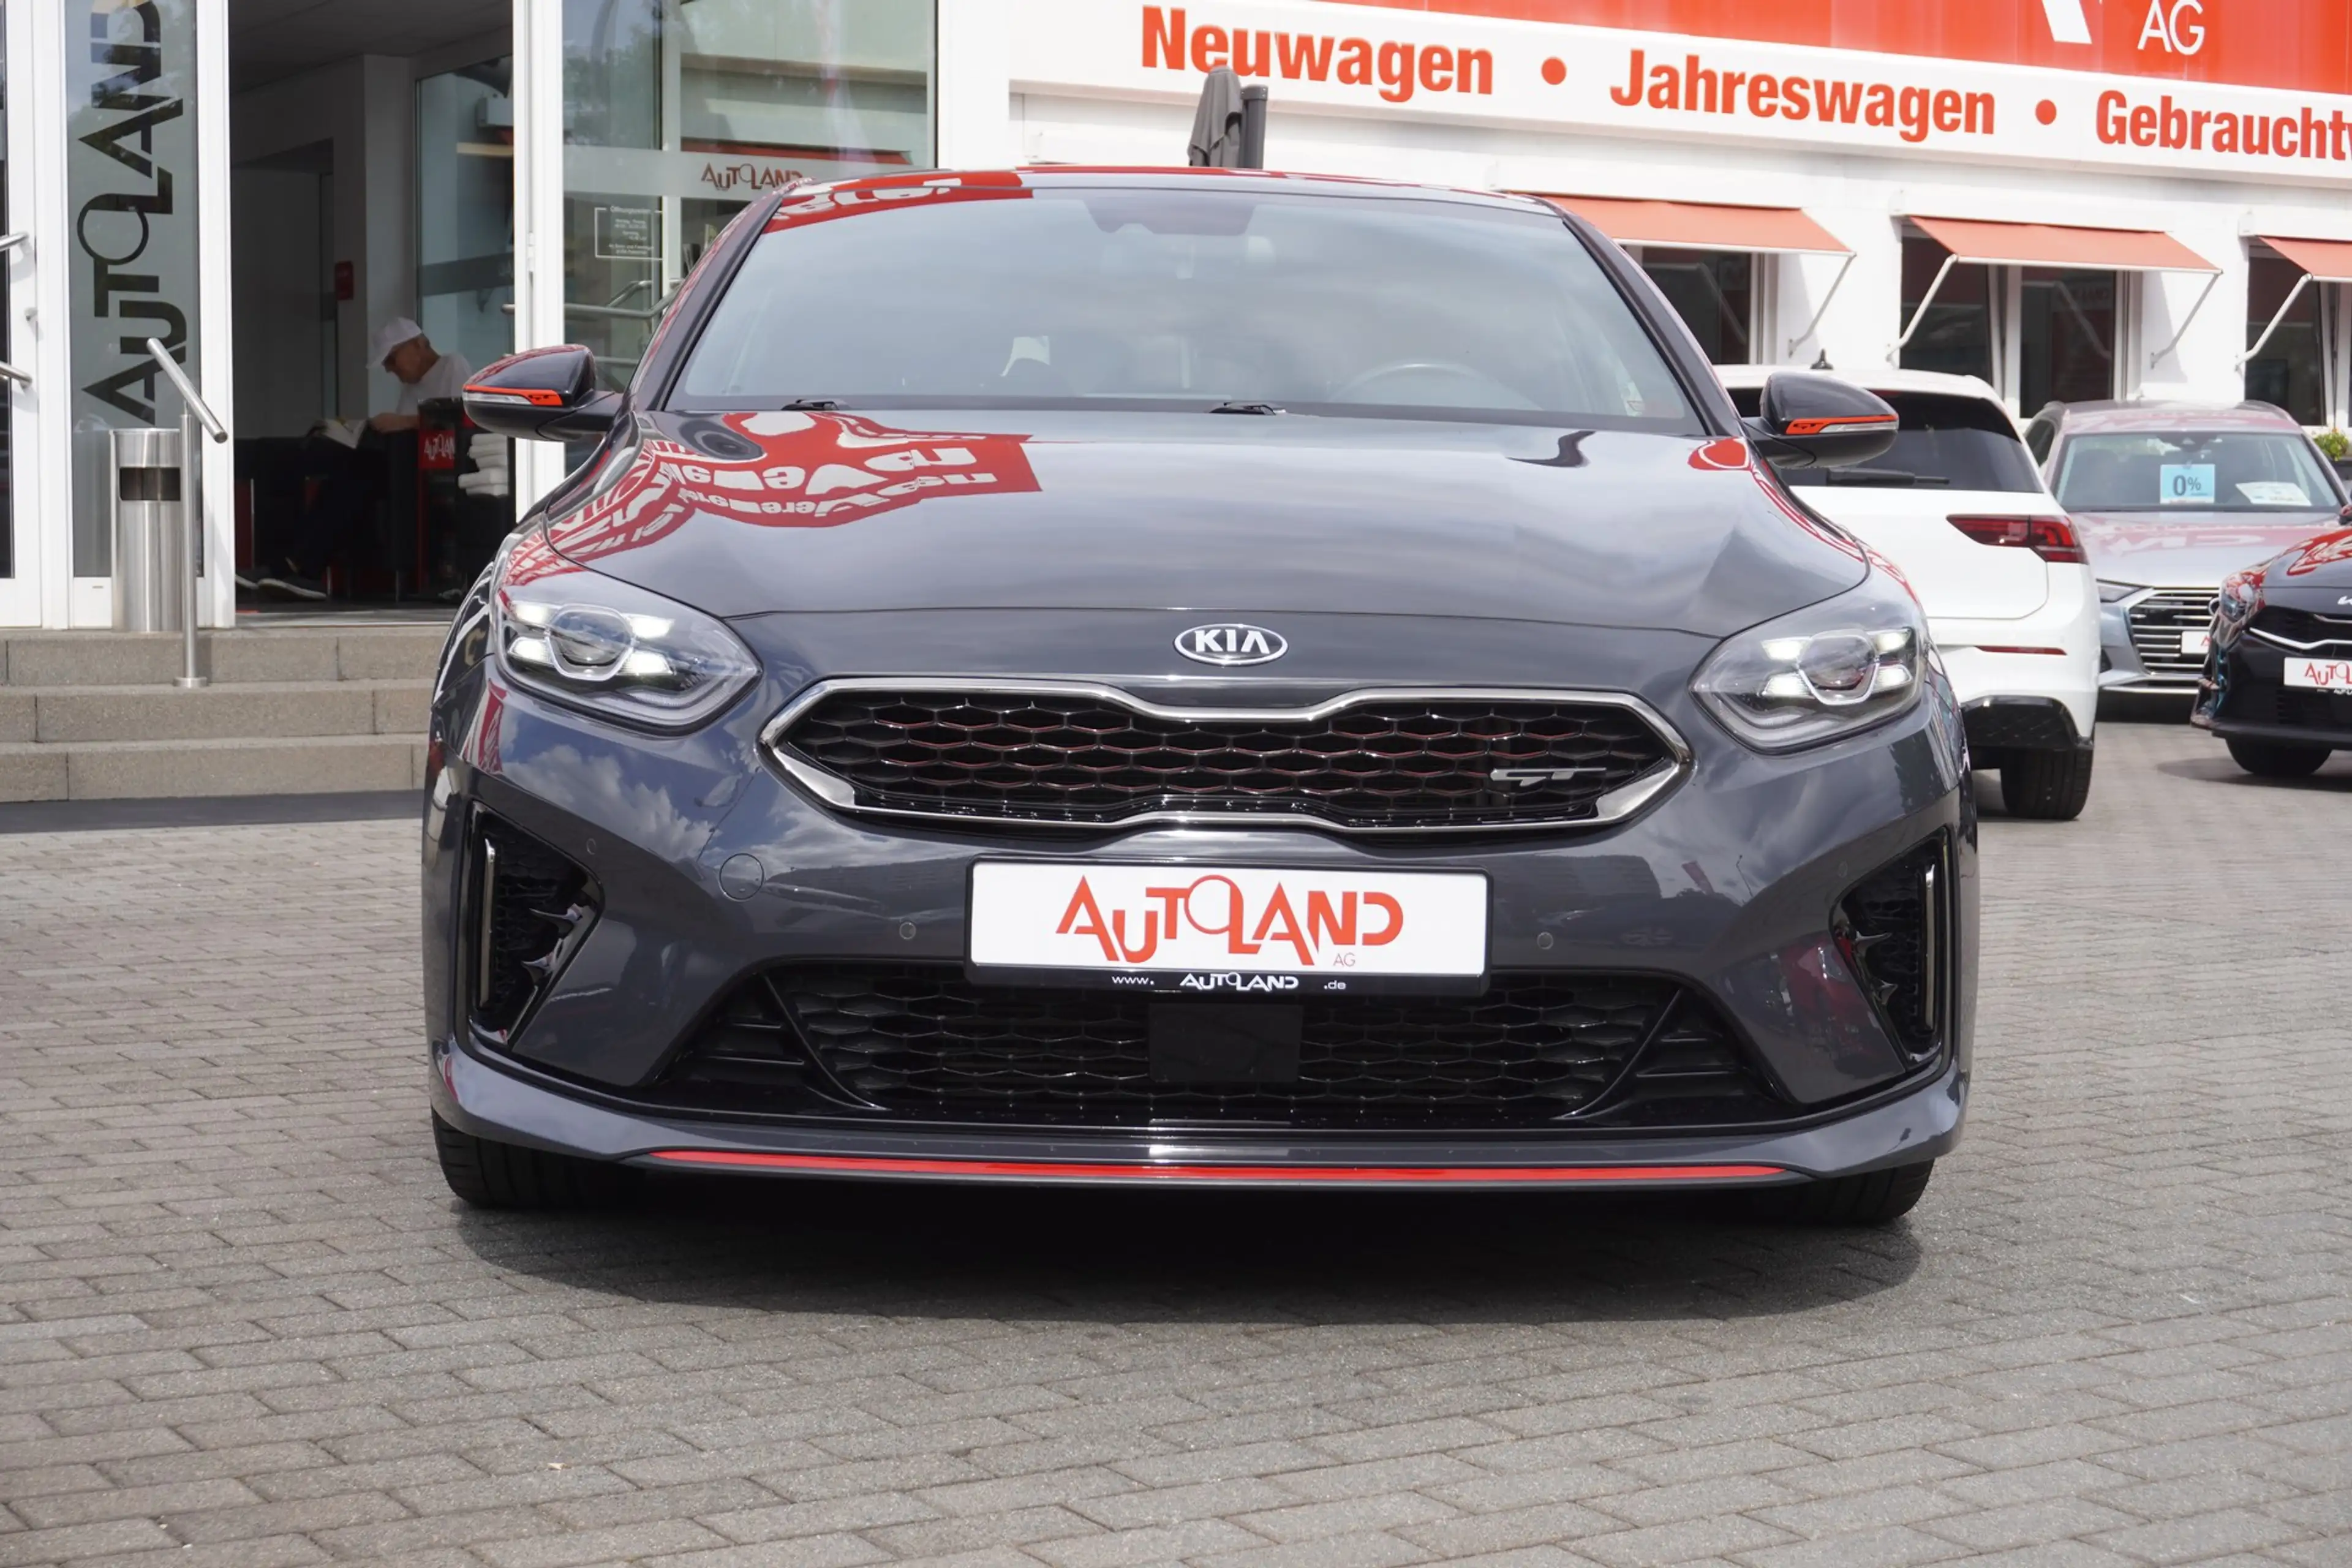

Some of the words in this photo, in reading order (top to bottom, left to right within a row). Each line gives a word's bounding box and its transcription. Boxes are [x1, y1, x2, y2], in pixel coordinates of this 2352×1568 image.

[2137, 0, 2205, 55] AG
[1142, 5, 1493, 103] Neuwagen
[1609, 49, 1996, 143] Jahreswagen
[2096, 89, 2352, 161] Gebraucht
[2173, 474, 2202, 497] 0%
[1194, 629, 1270, 654] KIA
[1055, 874, 1404, 966] AUTOLAND
[1332, 951, 1356, 967] AG
[1111, 975, 1155, 986] www.
[1179, 971, 1299, 992] AUTOLAND
[1324, 979, 1347, 990] .de
